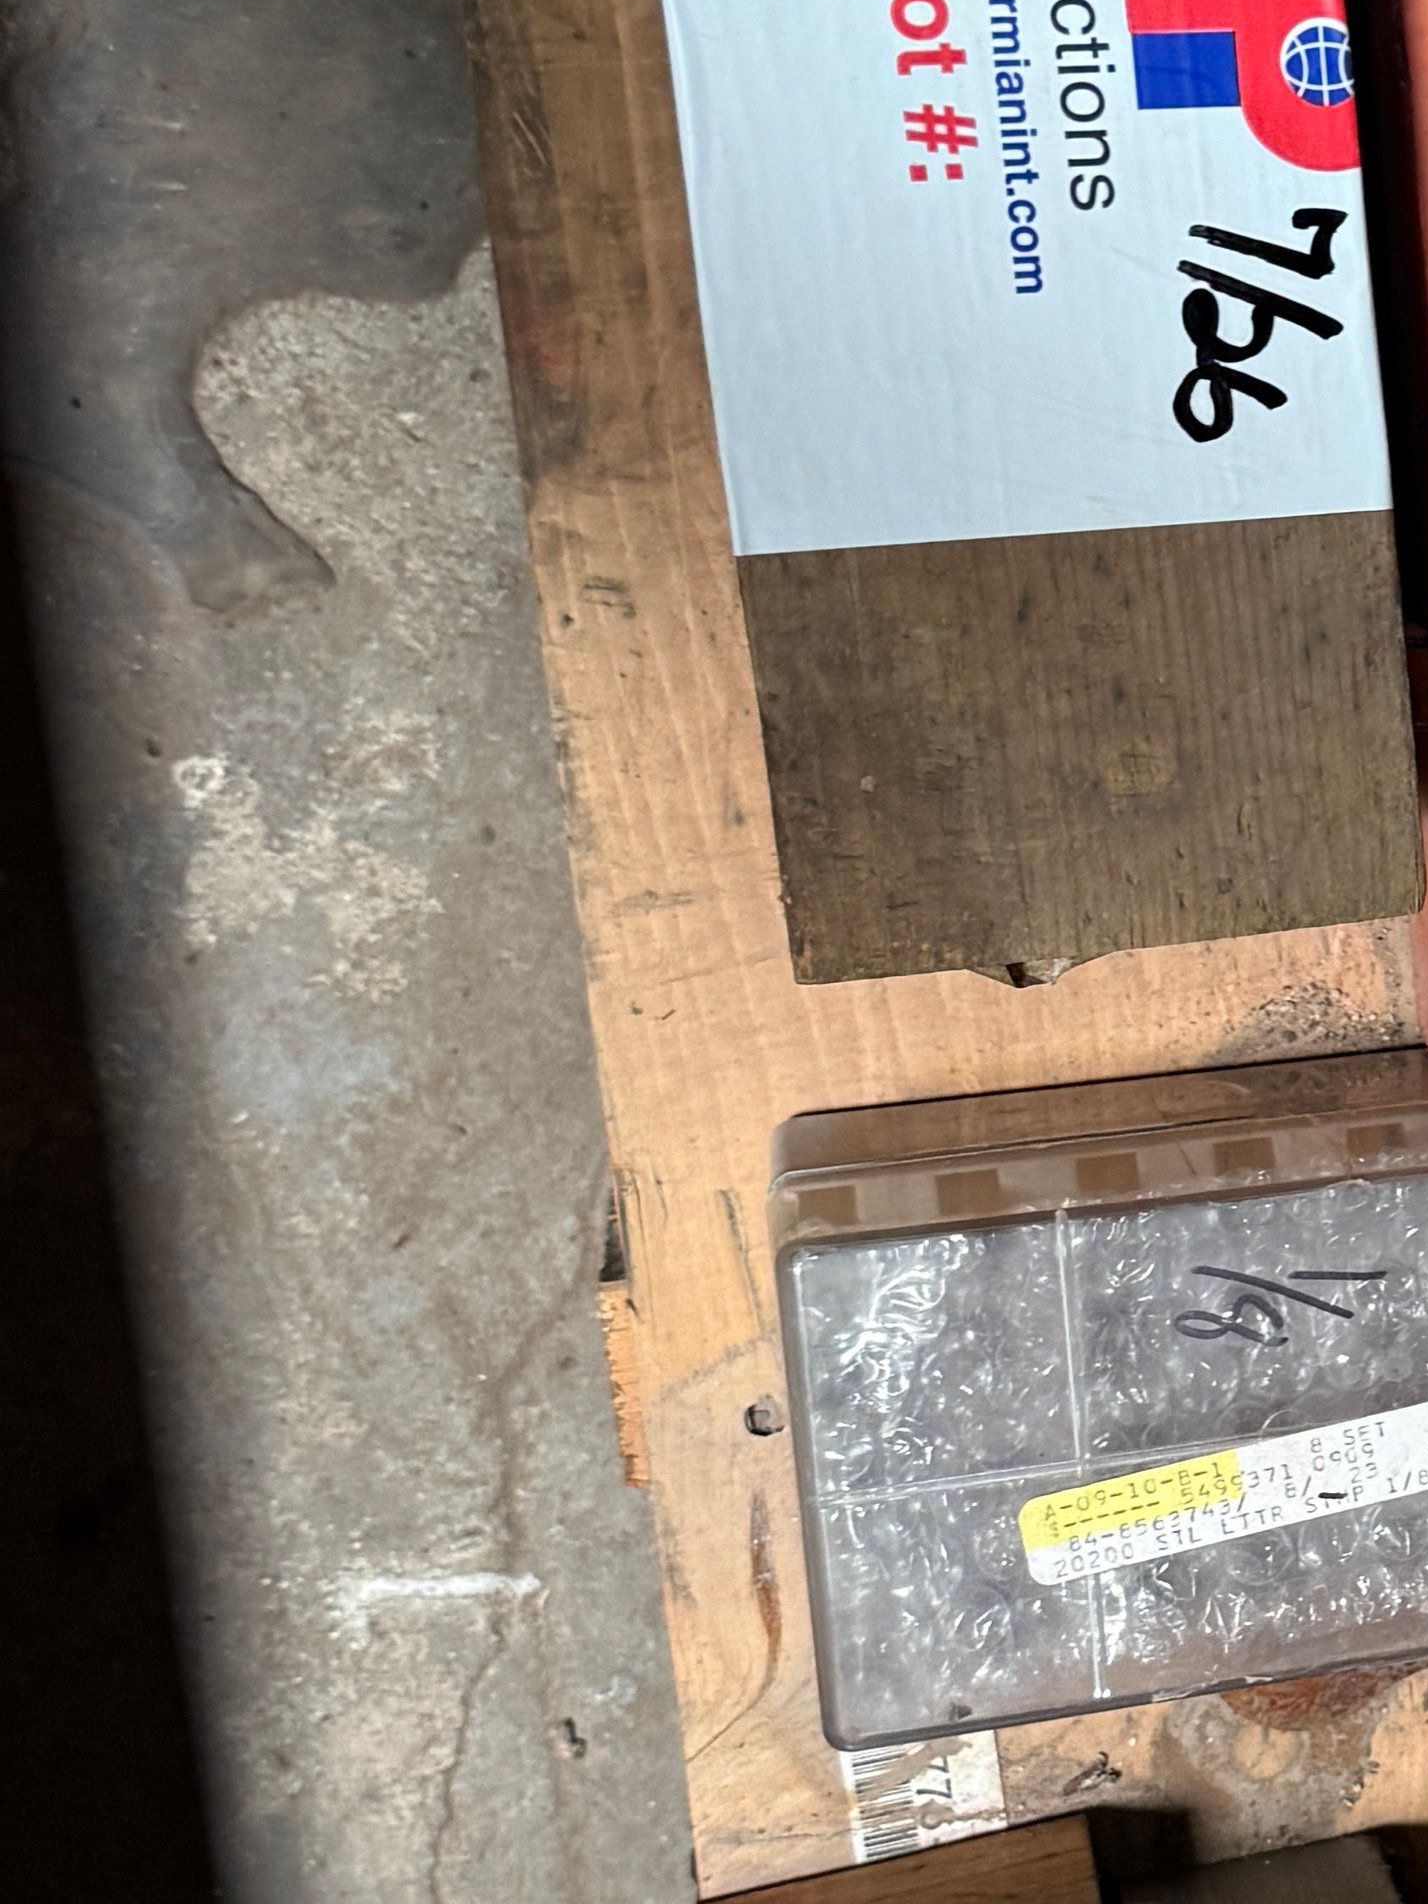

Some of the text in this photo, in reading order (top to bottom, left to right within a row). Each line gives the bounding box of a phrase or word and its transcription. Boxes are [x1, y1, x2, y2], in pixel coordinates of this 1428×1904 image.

[903, 103, 979, 185] #:
[1172, 207, 1348, 444] 7/26
[1173, 1266, 1389, 1348] 1/8
[1055, 1544, 1134, 1578] 20200
